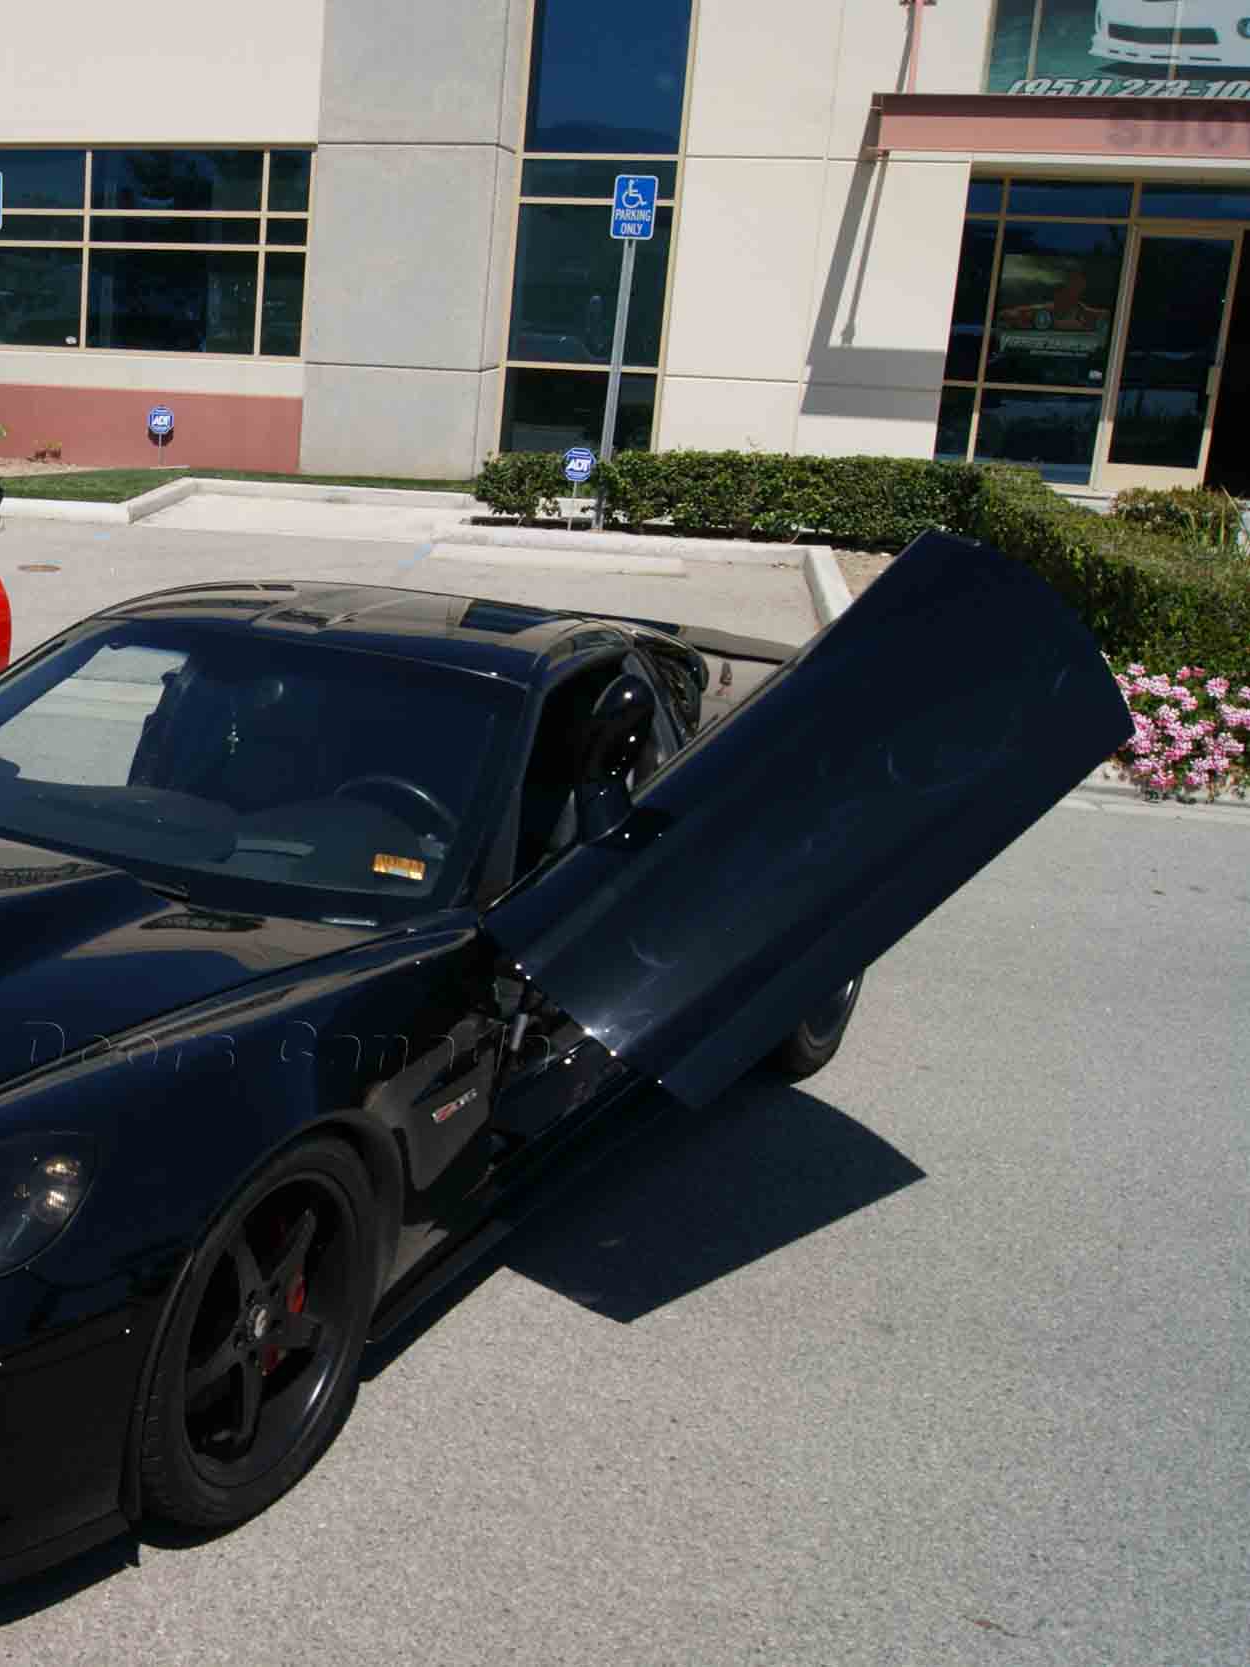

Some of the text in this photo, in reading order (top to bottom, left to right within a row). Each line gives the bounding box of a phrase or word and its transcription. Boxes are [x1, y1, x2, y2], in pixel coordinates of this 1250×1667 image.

[614, 208, 652, 222] PARKING
[621, 222, 643, 235] ONLY
[565, 458, 591, 471] ADT
